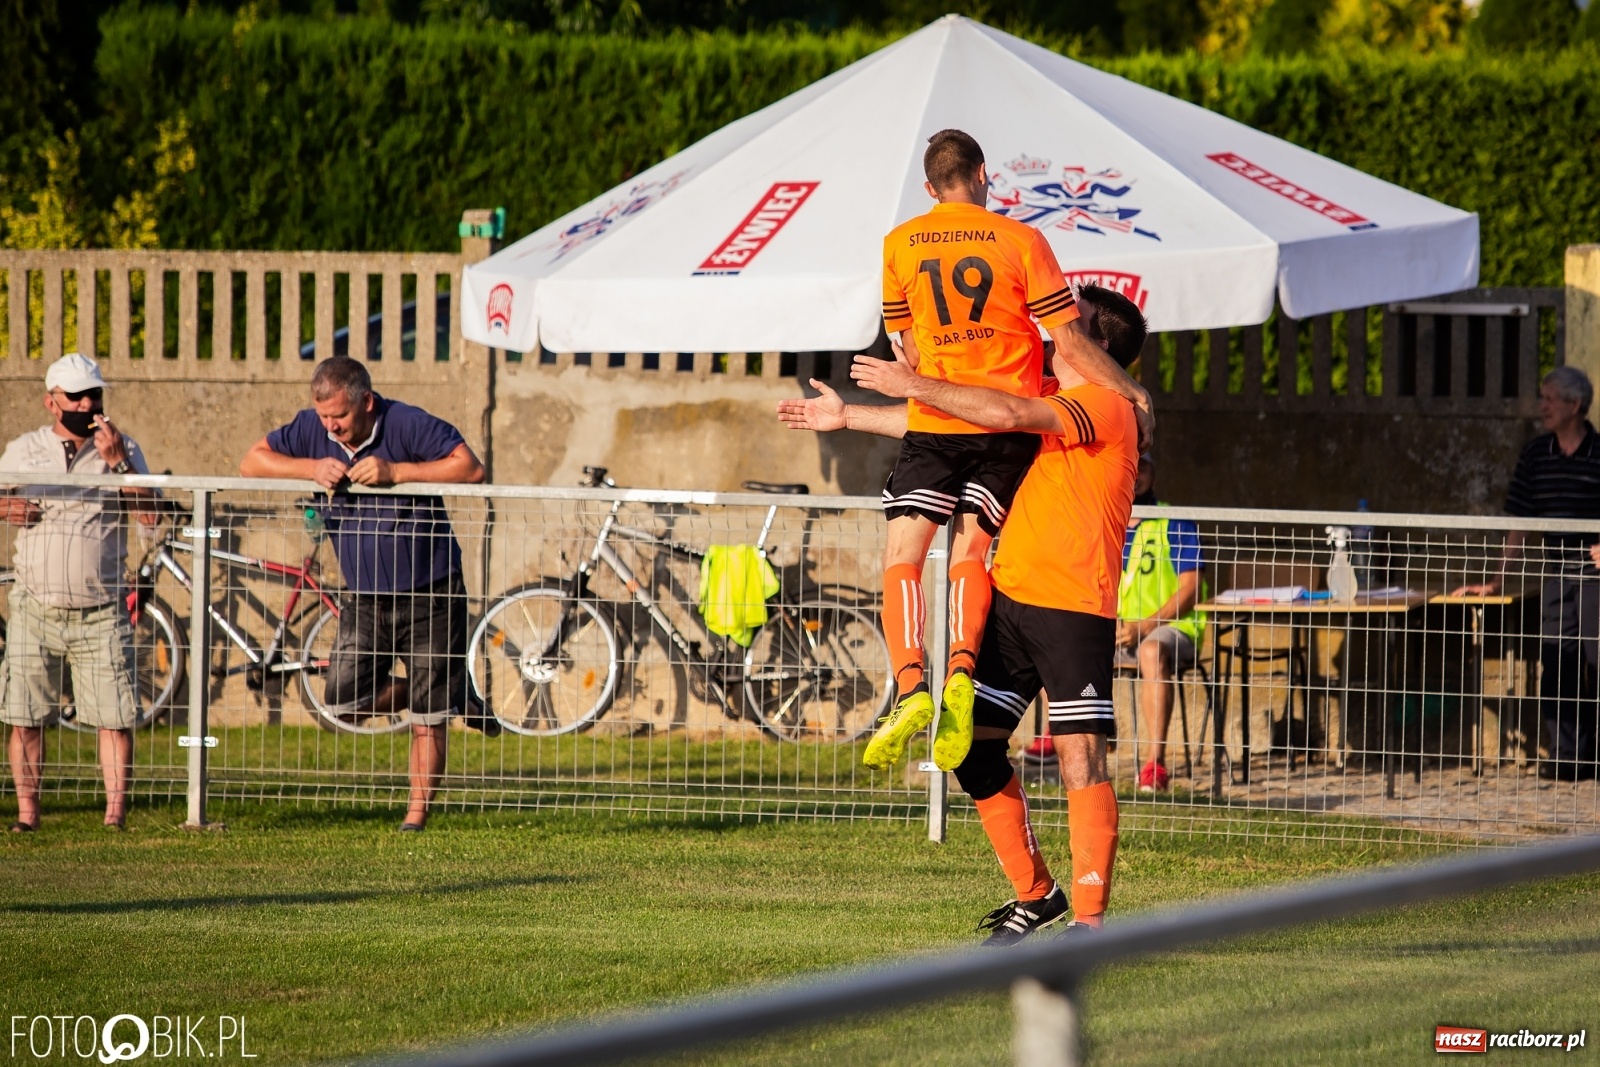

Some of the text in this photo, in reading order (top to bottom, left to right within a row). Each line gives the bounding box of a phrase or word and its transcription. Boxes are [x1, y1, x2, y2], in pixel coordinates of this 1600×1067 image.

[710, 185, 810, 266] ŻYWIEC
[909, 230, 997, 246] STUDZIENNA
[918, 255, 994, 327] 19
[932, 327, 995, 346] DAR-BUD
[1138, 539, 1157, 575] 5
